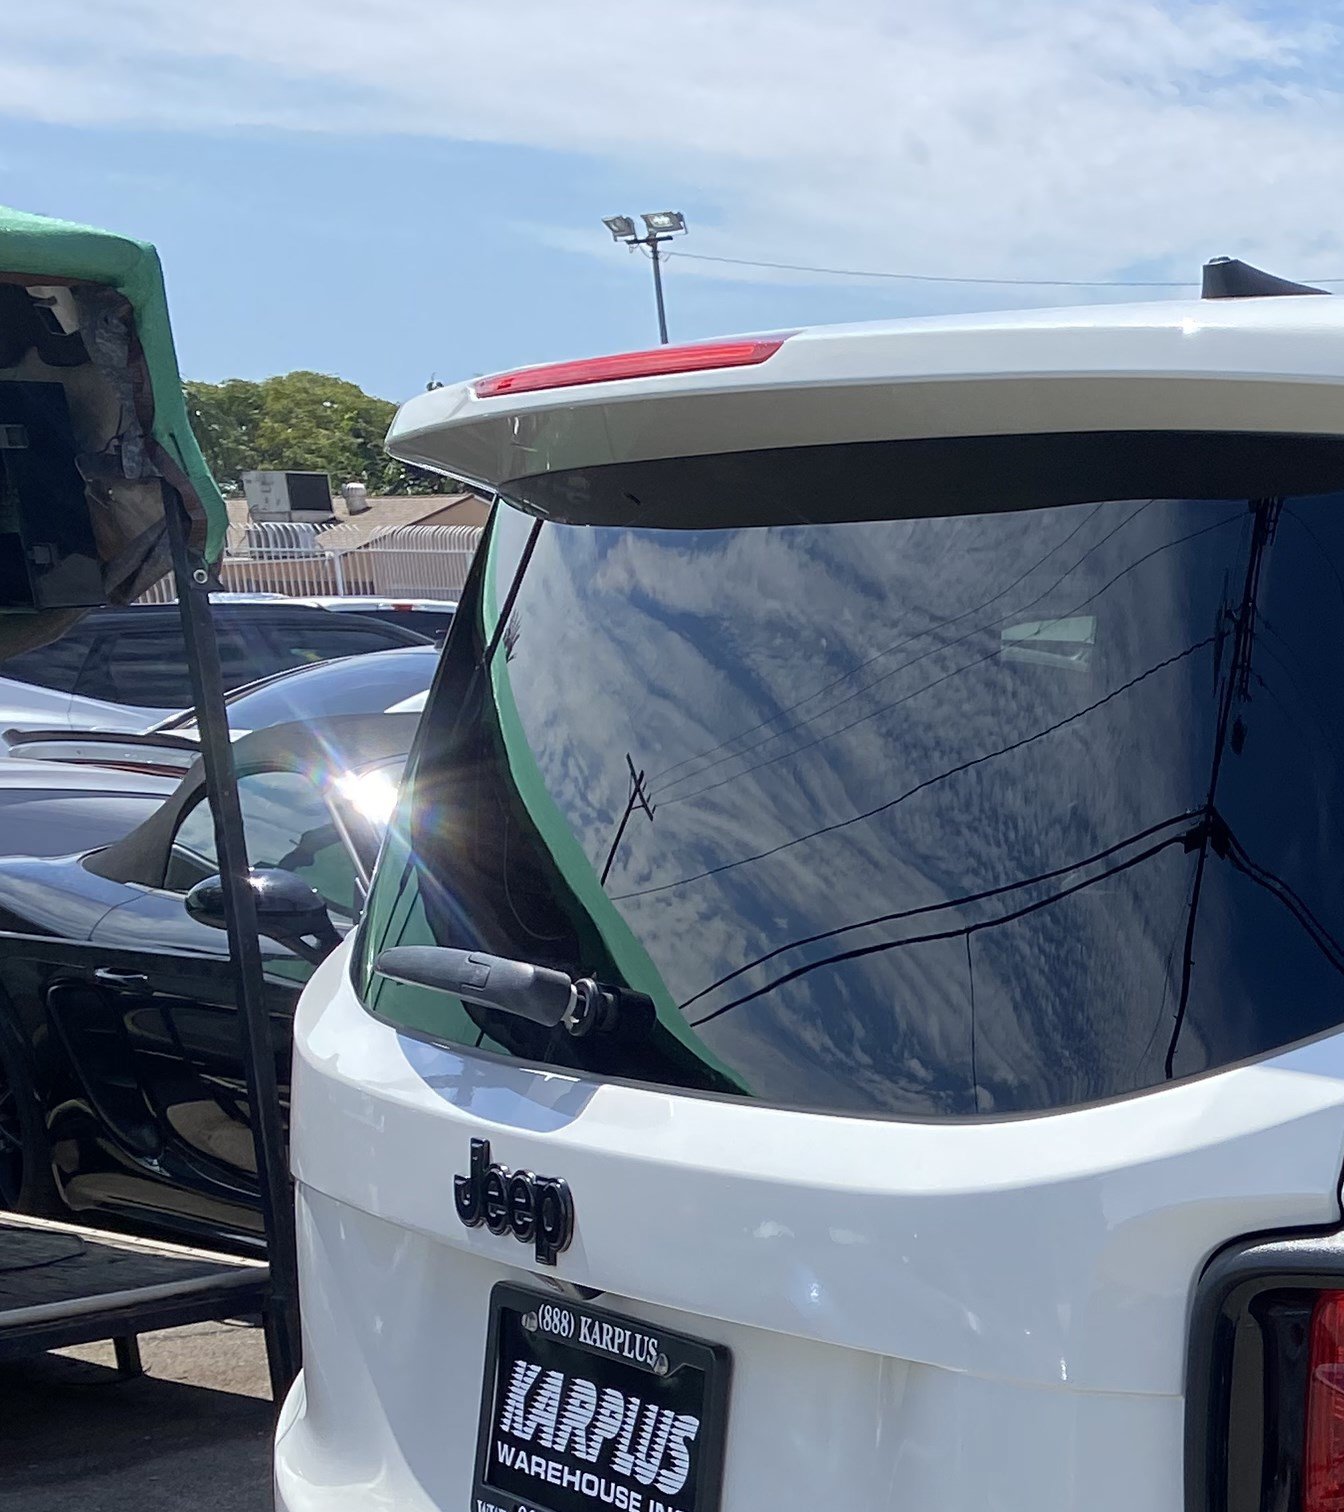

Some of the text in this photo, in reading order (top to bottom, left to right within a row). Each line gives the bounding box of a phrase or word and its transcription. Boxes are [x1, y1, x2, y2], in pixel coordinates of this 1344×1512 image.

[453, 1136, 574, 1266] Jeep
[537, 1303, 661, 1367] (888) KARPLUS
[500, 1359, 700, 1496] KARPLUS
